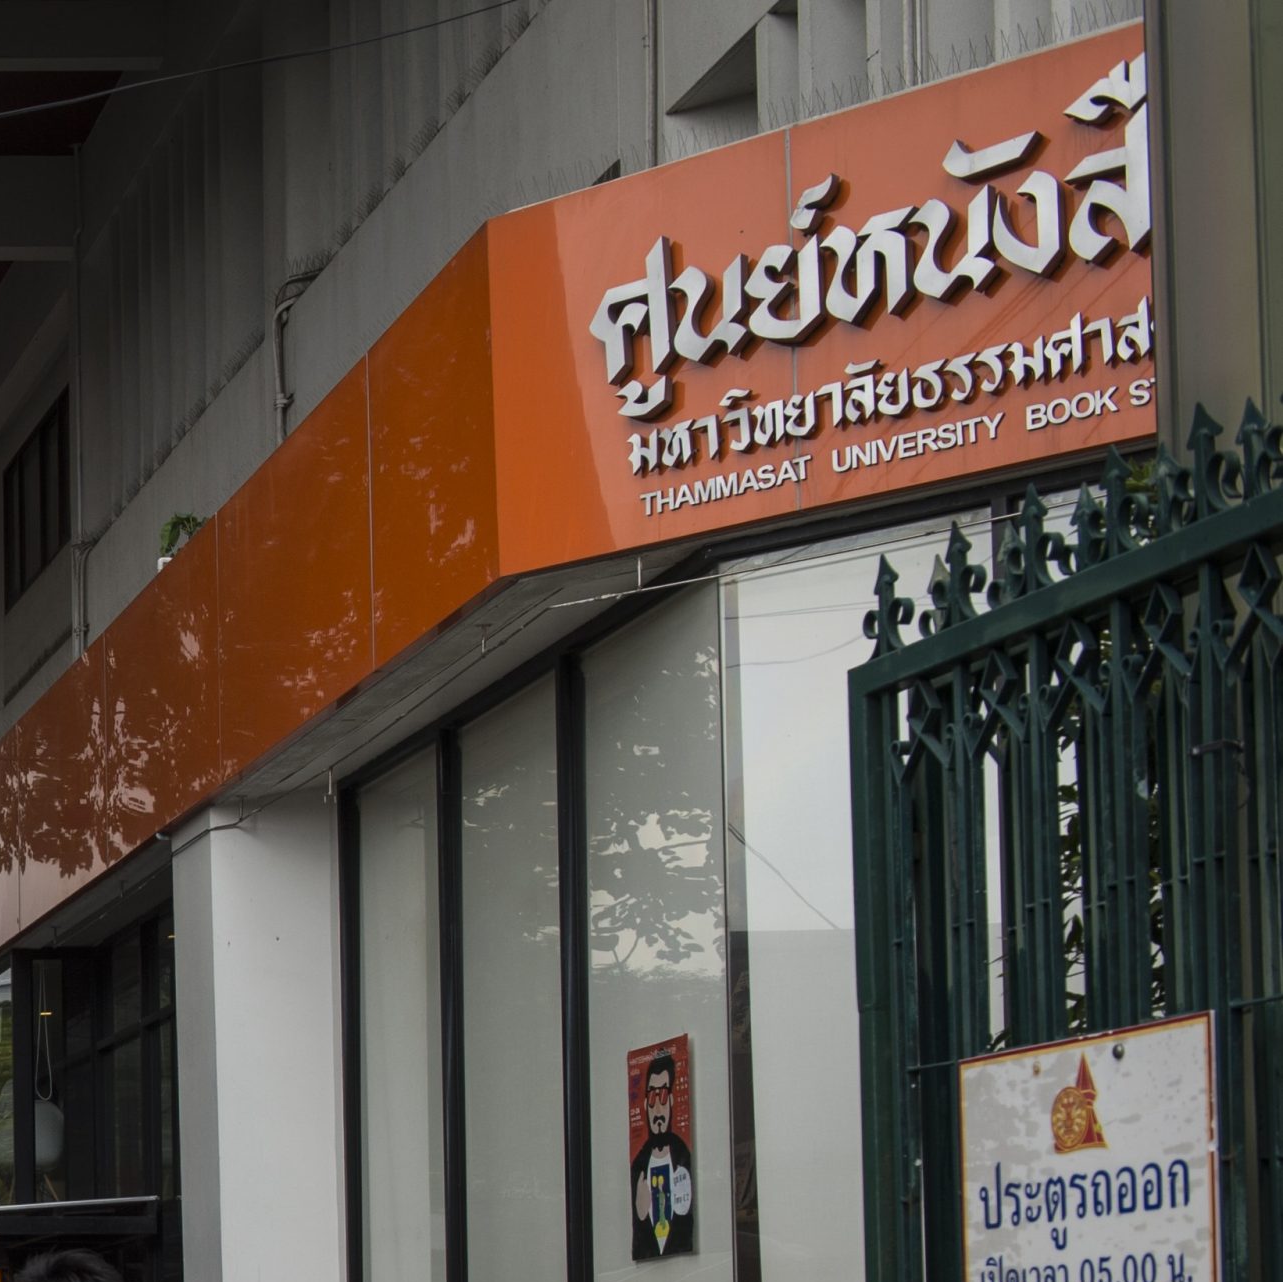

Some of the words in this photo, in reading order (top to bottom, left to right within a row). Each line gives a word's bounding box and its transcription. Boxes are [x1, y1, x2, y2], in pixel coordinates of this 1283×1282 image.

[627, 296, 1155, 474] มหาวิทยาลัยธรรมศาส
[639, 455, 811, 516] THAMMASAT
[831, 412, 1004, 474] UNIVERSITY
[1025, 386, 1117, 432] BOOK
[1129, 376, 1155, 406] S
[979, 1158, 1190, 1250] ประตูรถออก
